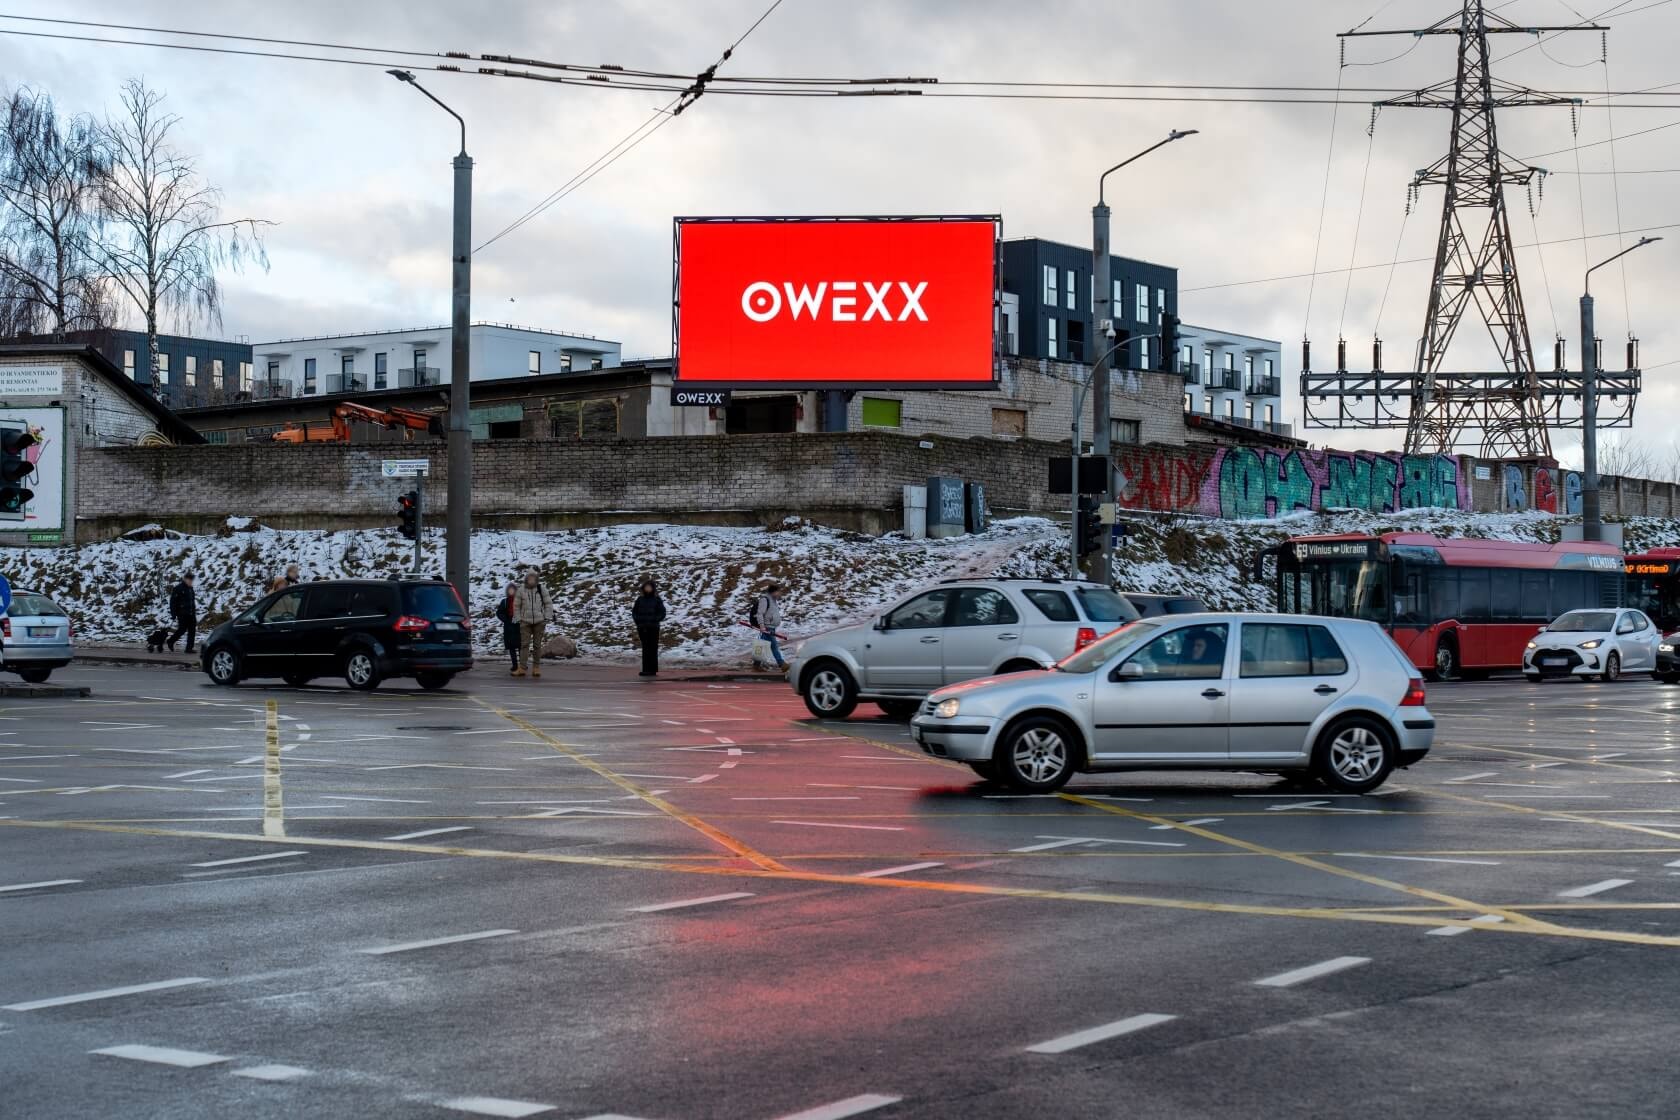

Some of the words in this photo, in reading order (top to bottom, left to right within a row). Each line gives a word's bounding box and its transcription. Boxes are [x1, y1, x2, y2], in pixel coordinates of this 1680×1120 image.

[741, 281, 929, 322] OWEXX
[1296, 543, 1308, 558] 69
[1309, 543, 1332, 555] Vilnius
[1587, 556, 1618, 569] VILNIUS
